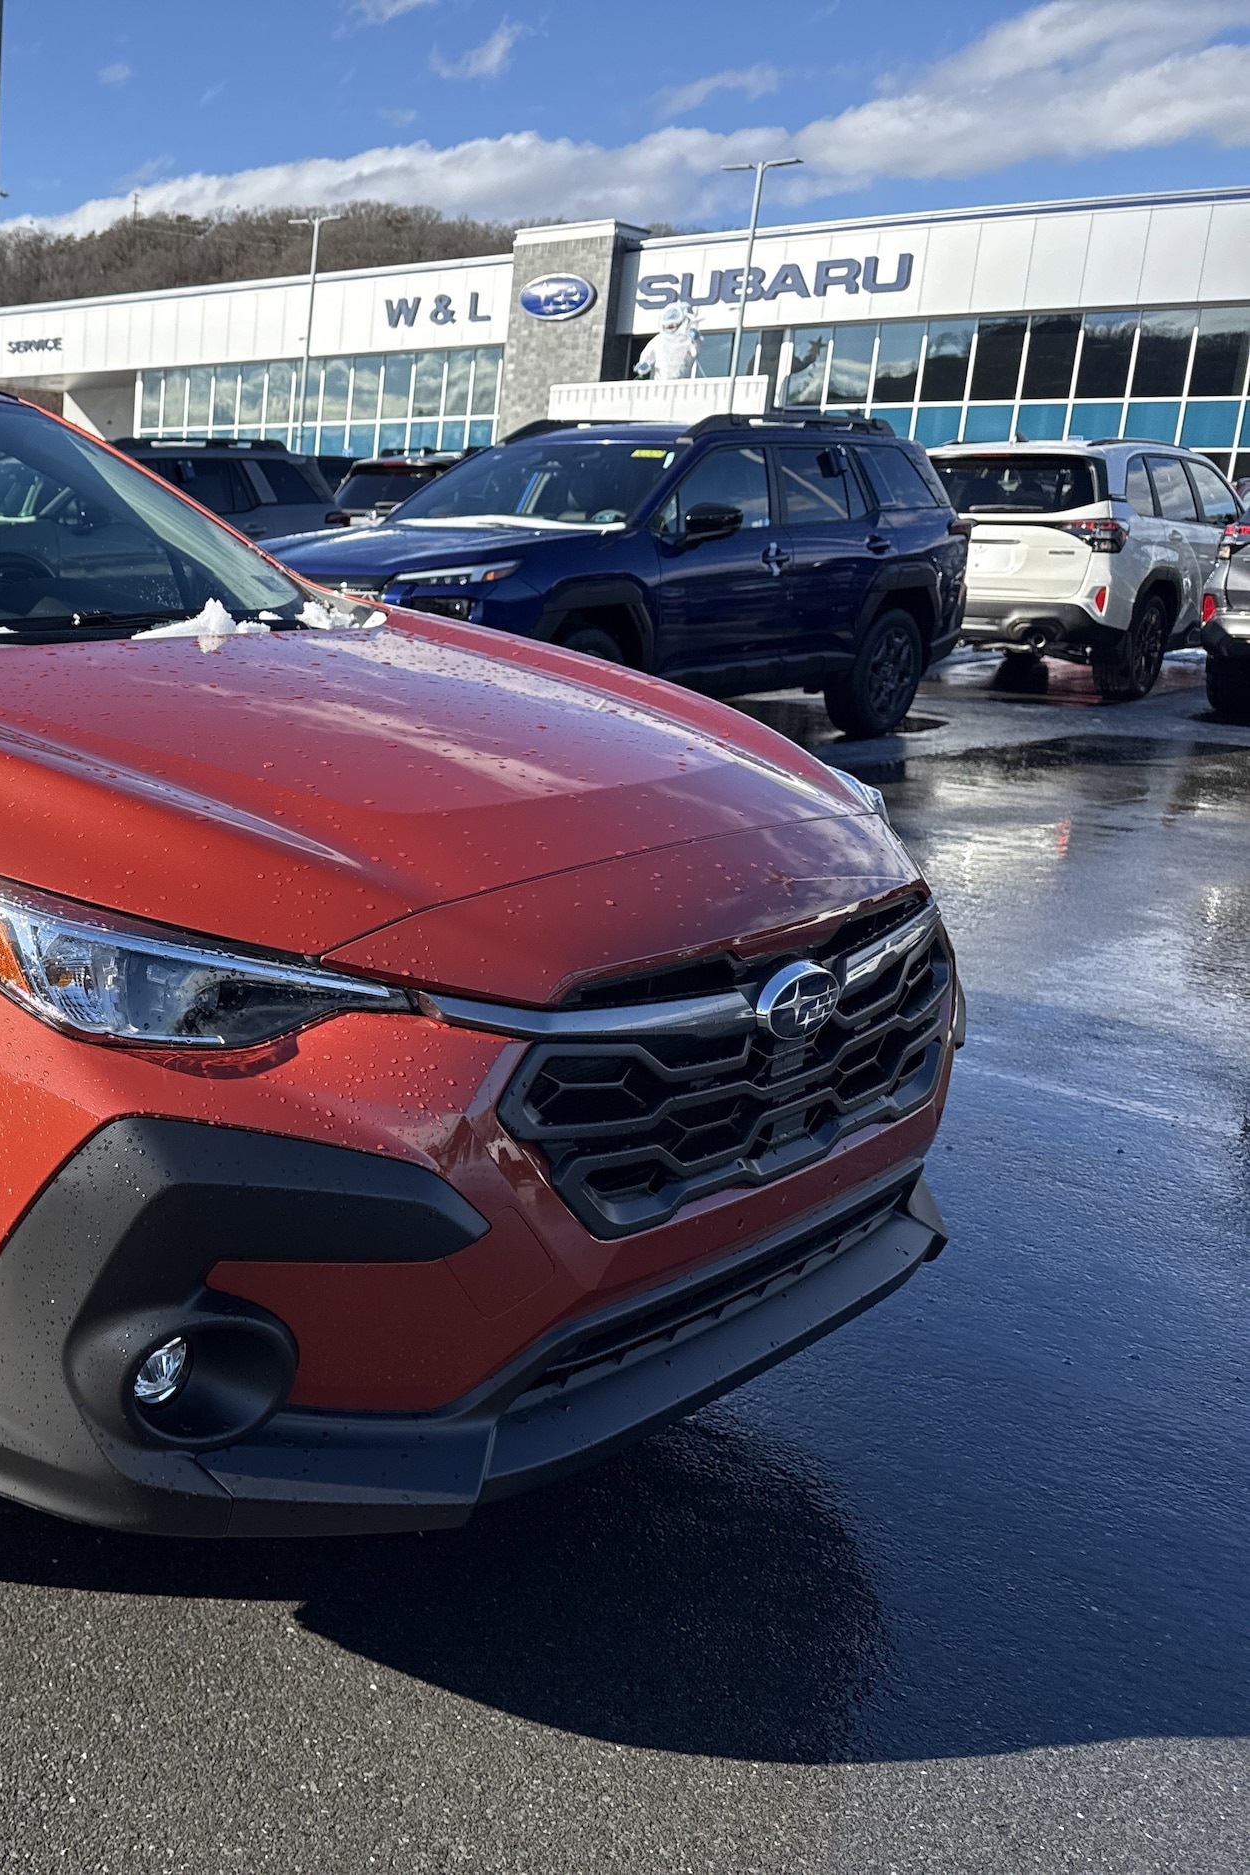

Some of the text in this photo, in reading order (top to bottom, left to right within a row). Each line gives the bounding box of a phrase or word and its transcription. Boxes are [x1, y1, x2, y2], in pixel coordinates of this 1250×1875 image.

[636, 253, 914, 311] SUBARU
[385, 291, 492, 328] W & L
[6, 337, 63, 354] SERVICE
